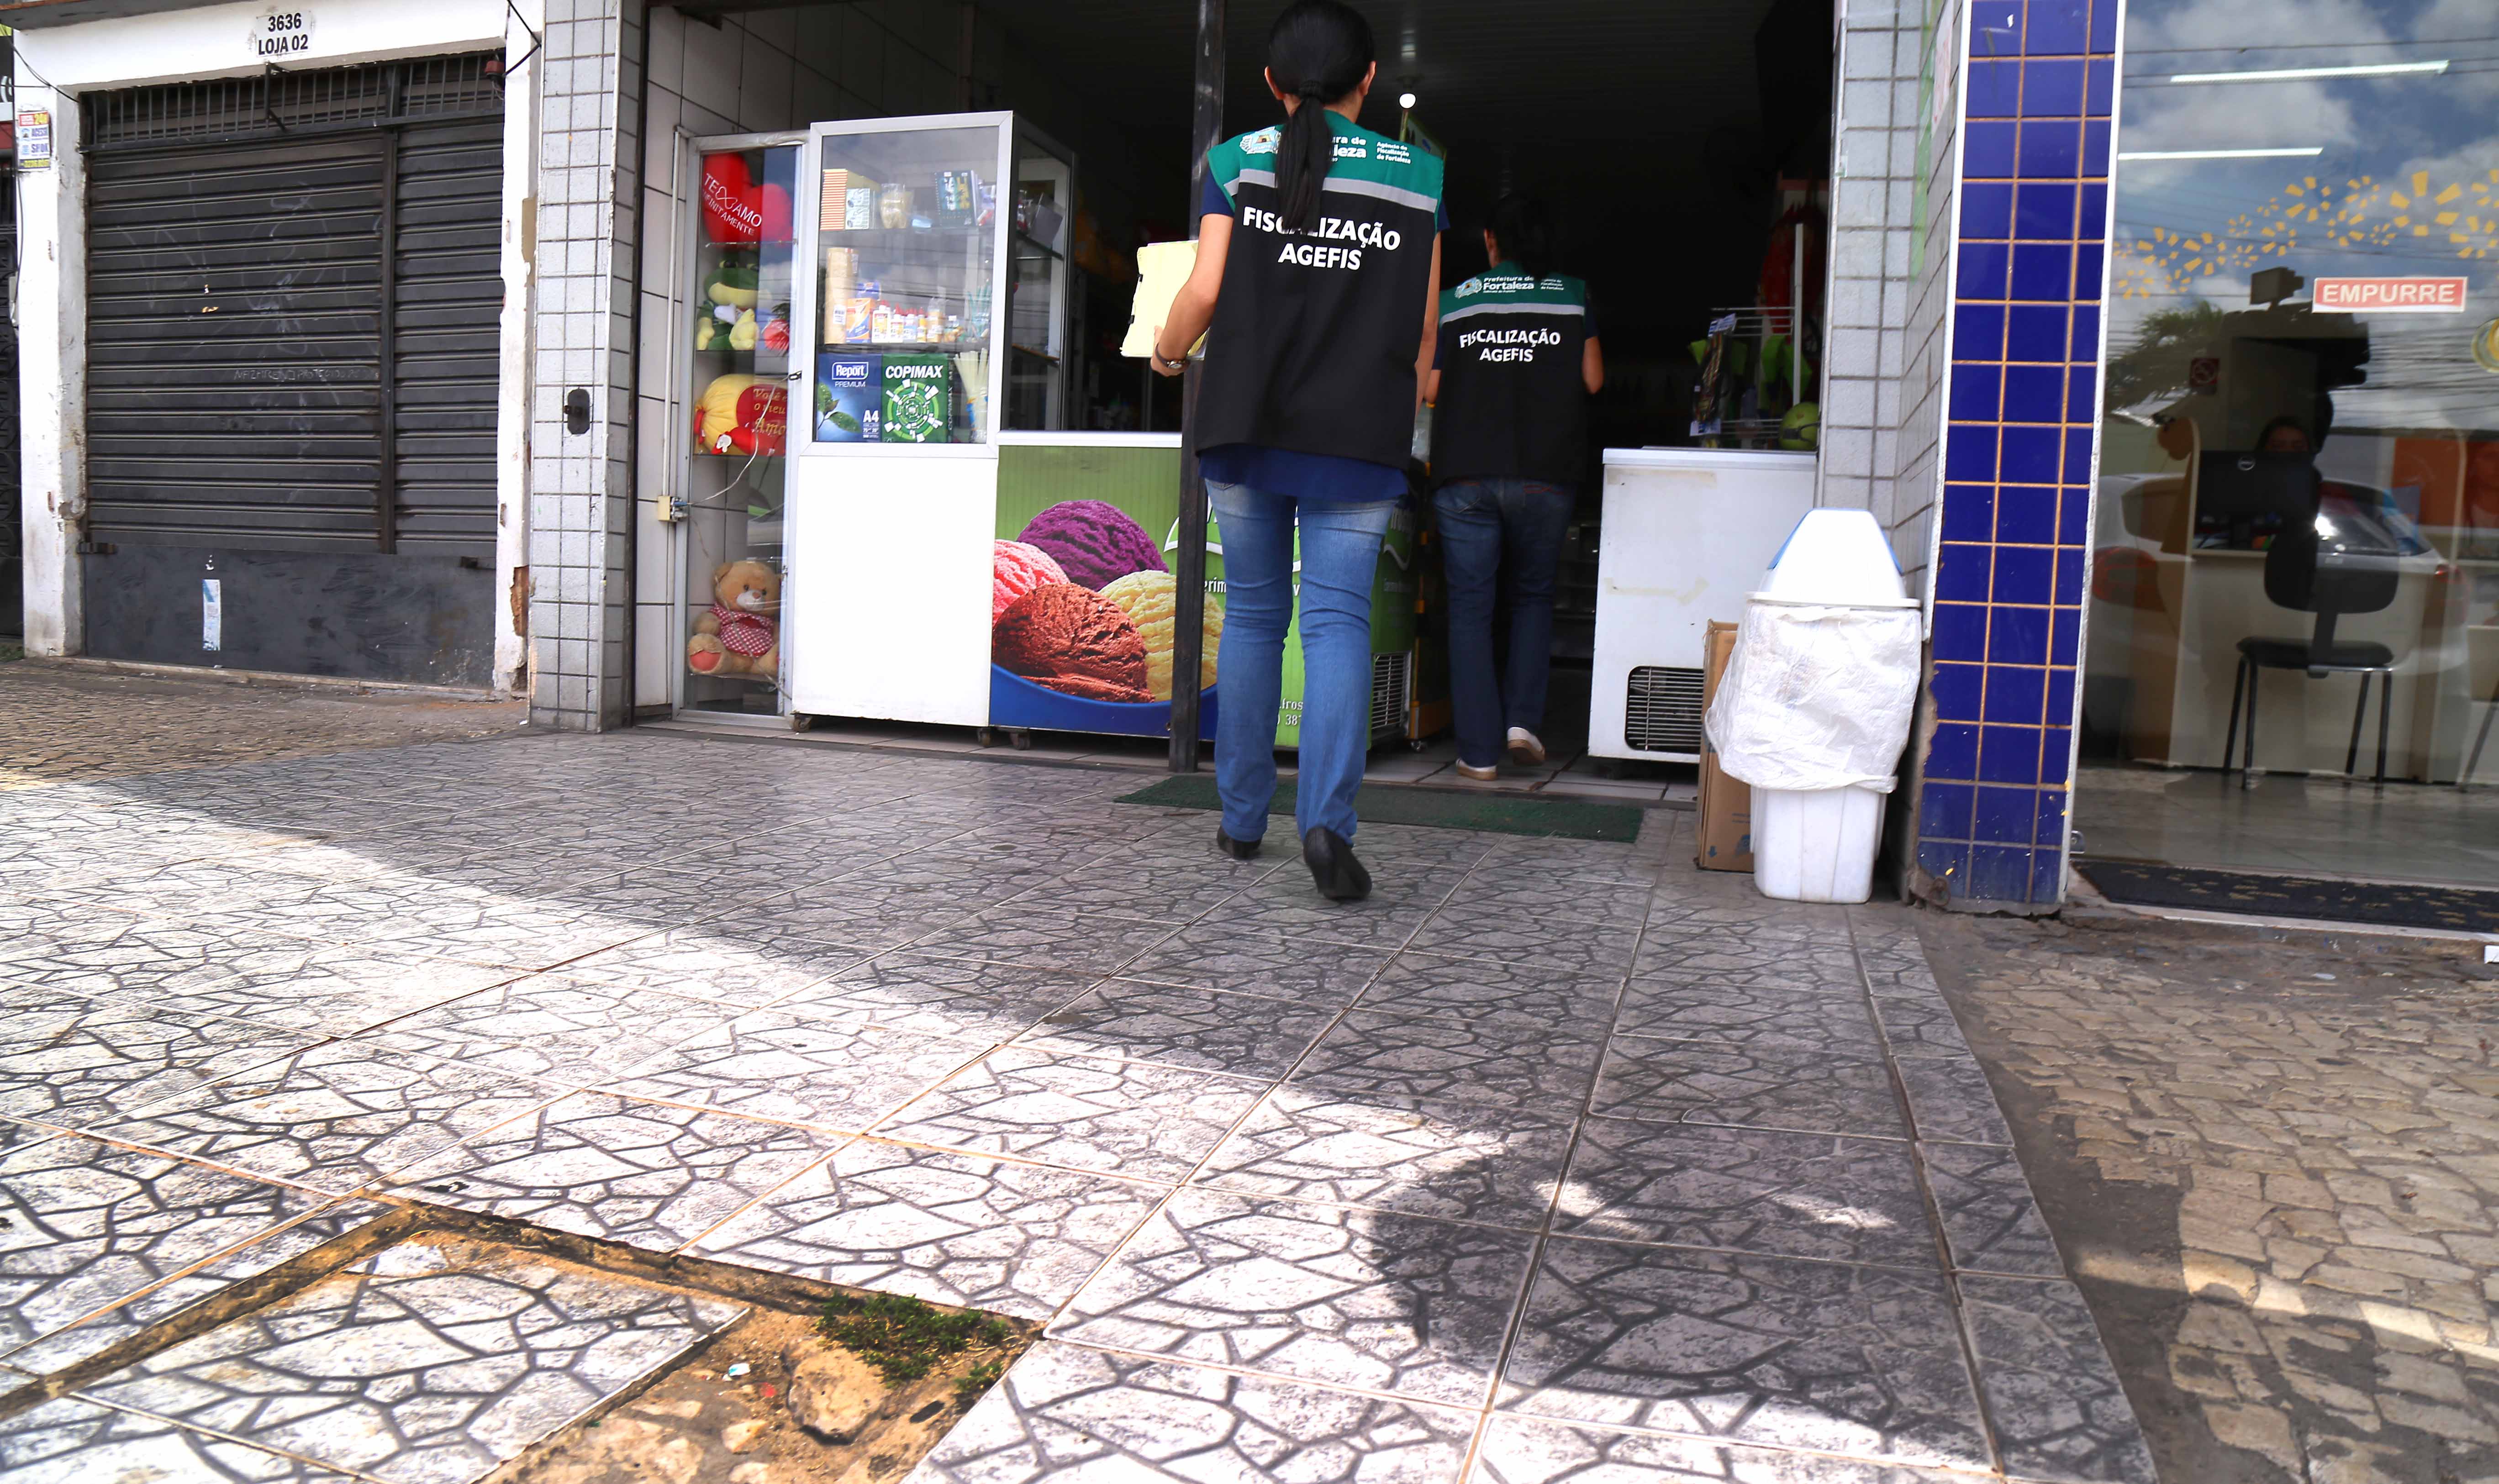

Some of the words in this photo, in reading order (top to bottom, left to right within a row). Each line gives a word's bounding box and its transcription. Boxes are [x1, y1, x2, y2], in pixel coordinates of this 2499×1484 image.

[268, 13, 301, 32] 3636
[258, 37, 289, 55] LOJA
[292, 34, 308, 50] 02
[1351, 137, 1366, 145] de
[705, 173, 719, 193] TE
[732, 203, 762, 227] AMO
[1278, 243, 1362, 270] AGEFIS
[1483, 281, 1534, 290] Fortaleza
[2323, 284, 2456, 303] EMPURRE
[1460, 328, 1561, 348] FISCALIZAÇÃO
[1480, 348, 1533, 362] AGEFIS
[836, 365, 865, 378] Report
[886, 365, 944, 379] COPIMAX
[863, 410, 880, 422] A4
